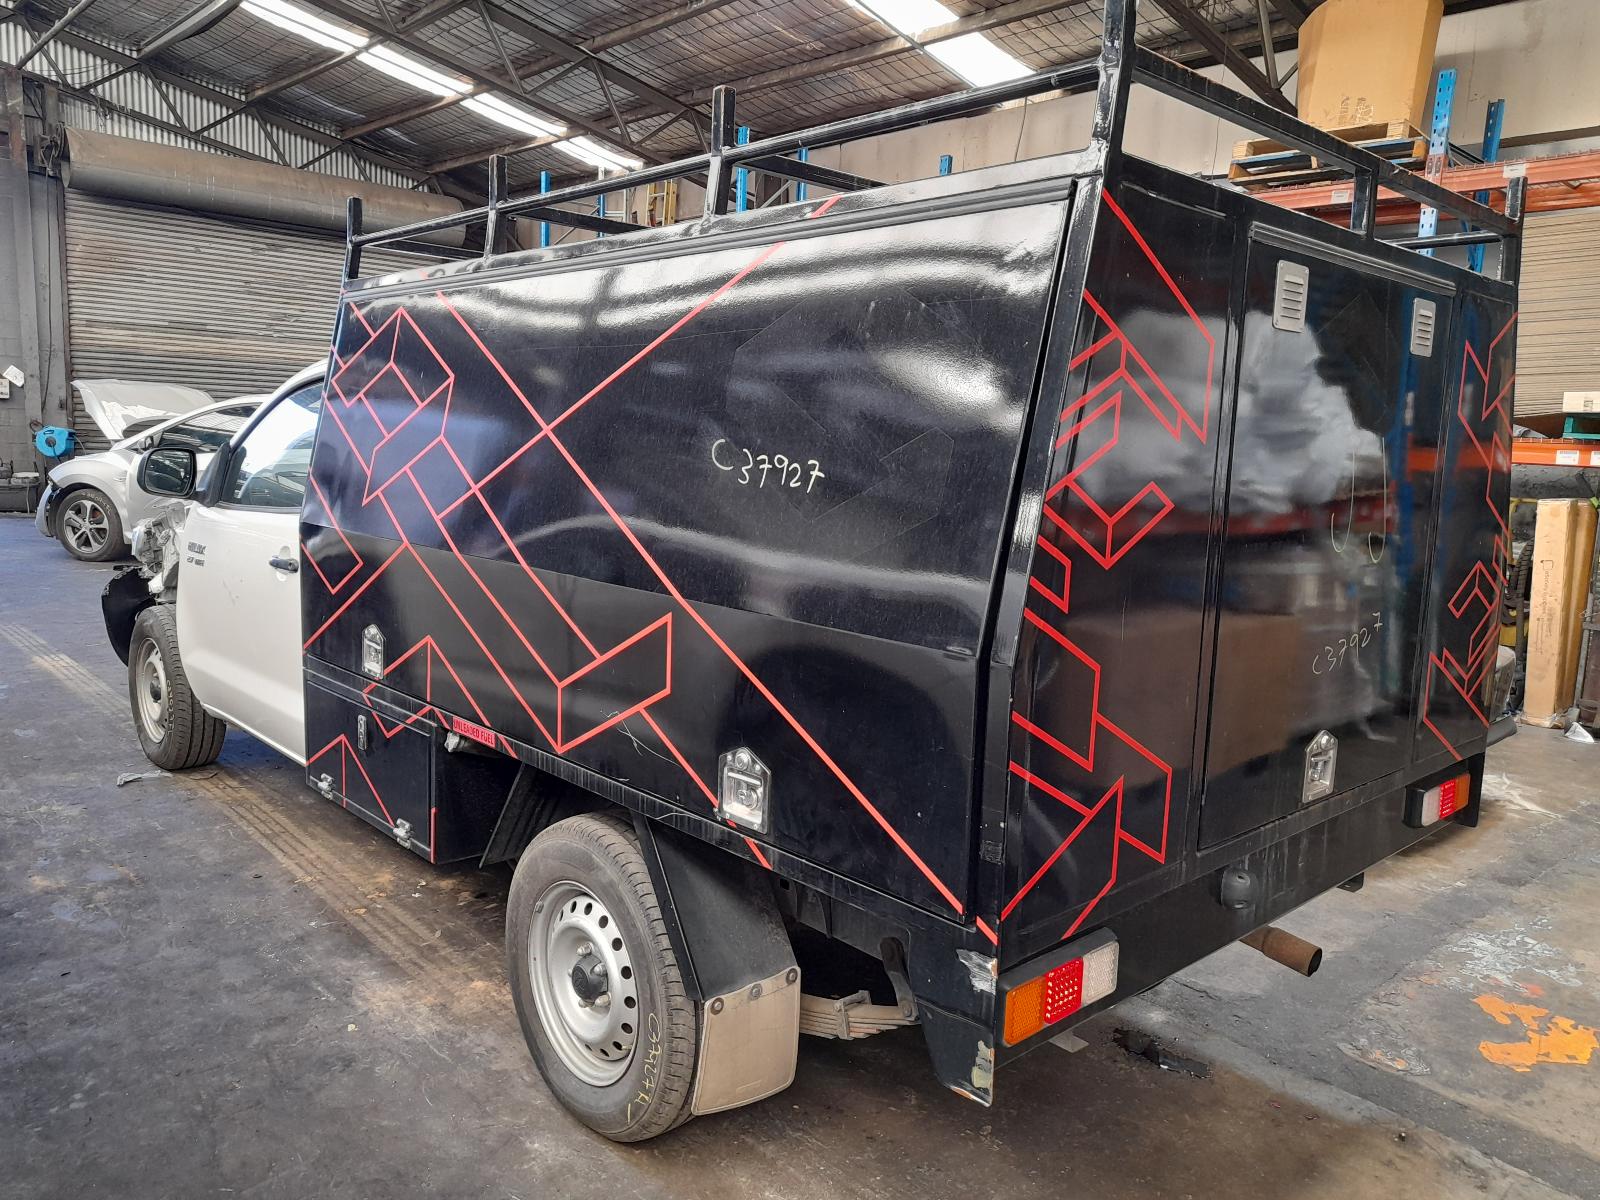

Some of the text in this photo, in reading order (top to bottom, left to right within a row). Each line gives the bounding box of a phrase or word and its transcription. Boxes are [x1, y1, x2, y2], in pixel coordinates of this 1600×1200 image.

[712, 439, 825, 493] C37927
[1312, 611, 1383, 675] C37927
[453, 719, 494, 745] UNLEADED FUEL
